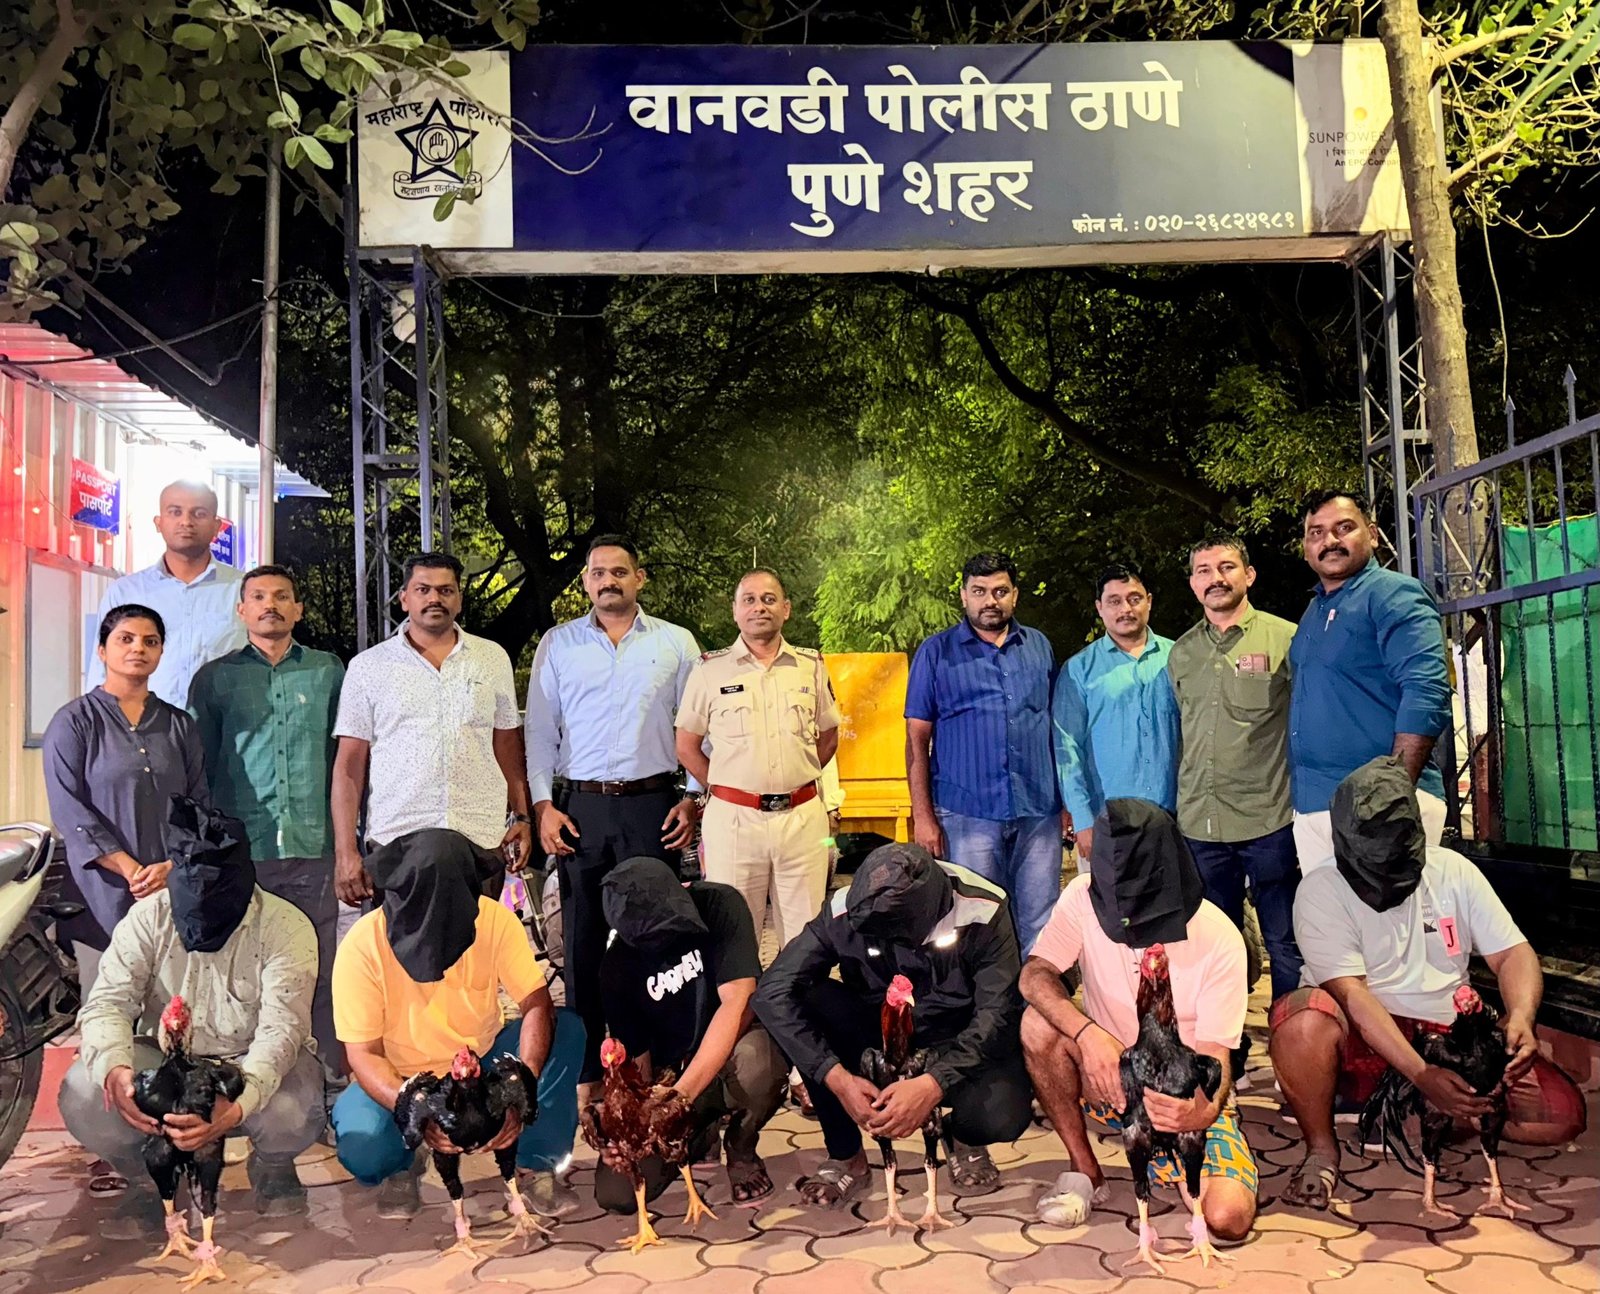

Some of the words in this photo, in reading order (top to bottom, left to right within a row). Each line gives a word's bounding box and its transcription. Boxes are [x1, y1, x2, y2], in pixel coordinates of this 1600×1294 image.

[626, 67, 849, 134] वानवडी
[864, 64, 1052, 133] पोलीस
[1067, 61, 1183, 131] ठाणे
[365, 101, 424, 125] महाराष्ट्र
[1308, 131, 1386, 144] SUNPOWER
[1335, 159, 1345, 167] An
[1348, 159, 1365, 167] EPC
[1367, 159, 1399, 168] Compa
[787, 143, 884, 238] पुणे
[902, 160, 1034, 223] शहर
[1072, 214, 1107, 233] फोन
[1109, 213, 1129, 233] नं.
[1144, 211, 1295, 232] ०२०-२६८२४९८१
[75, 469, 117, 497] PASSPORT
[79, 491, 114, 517] पासपोर्ट
[1445, 924, 1454, 948] J
